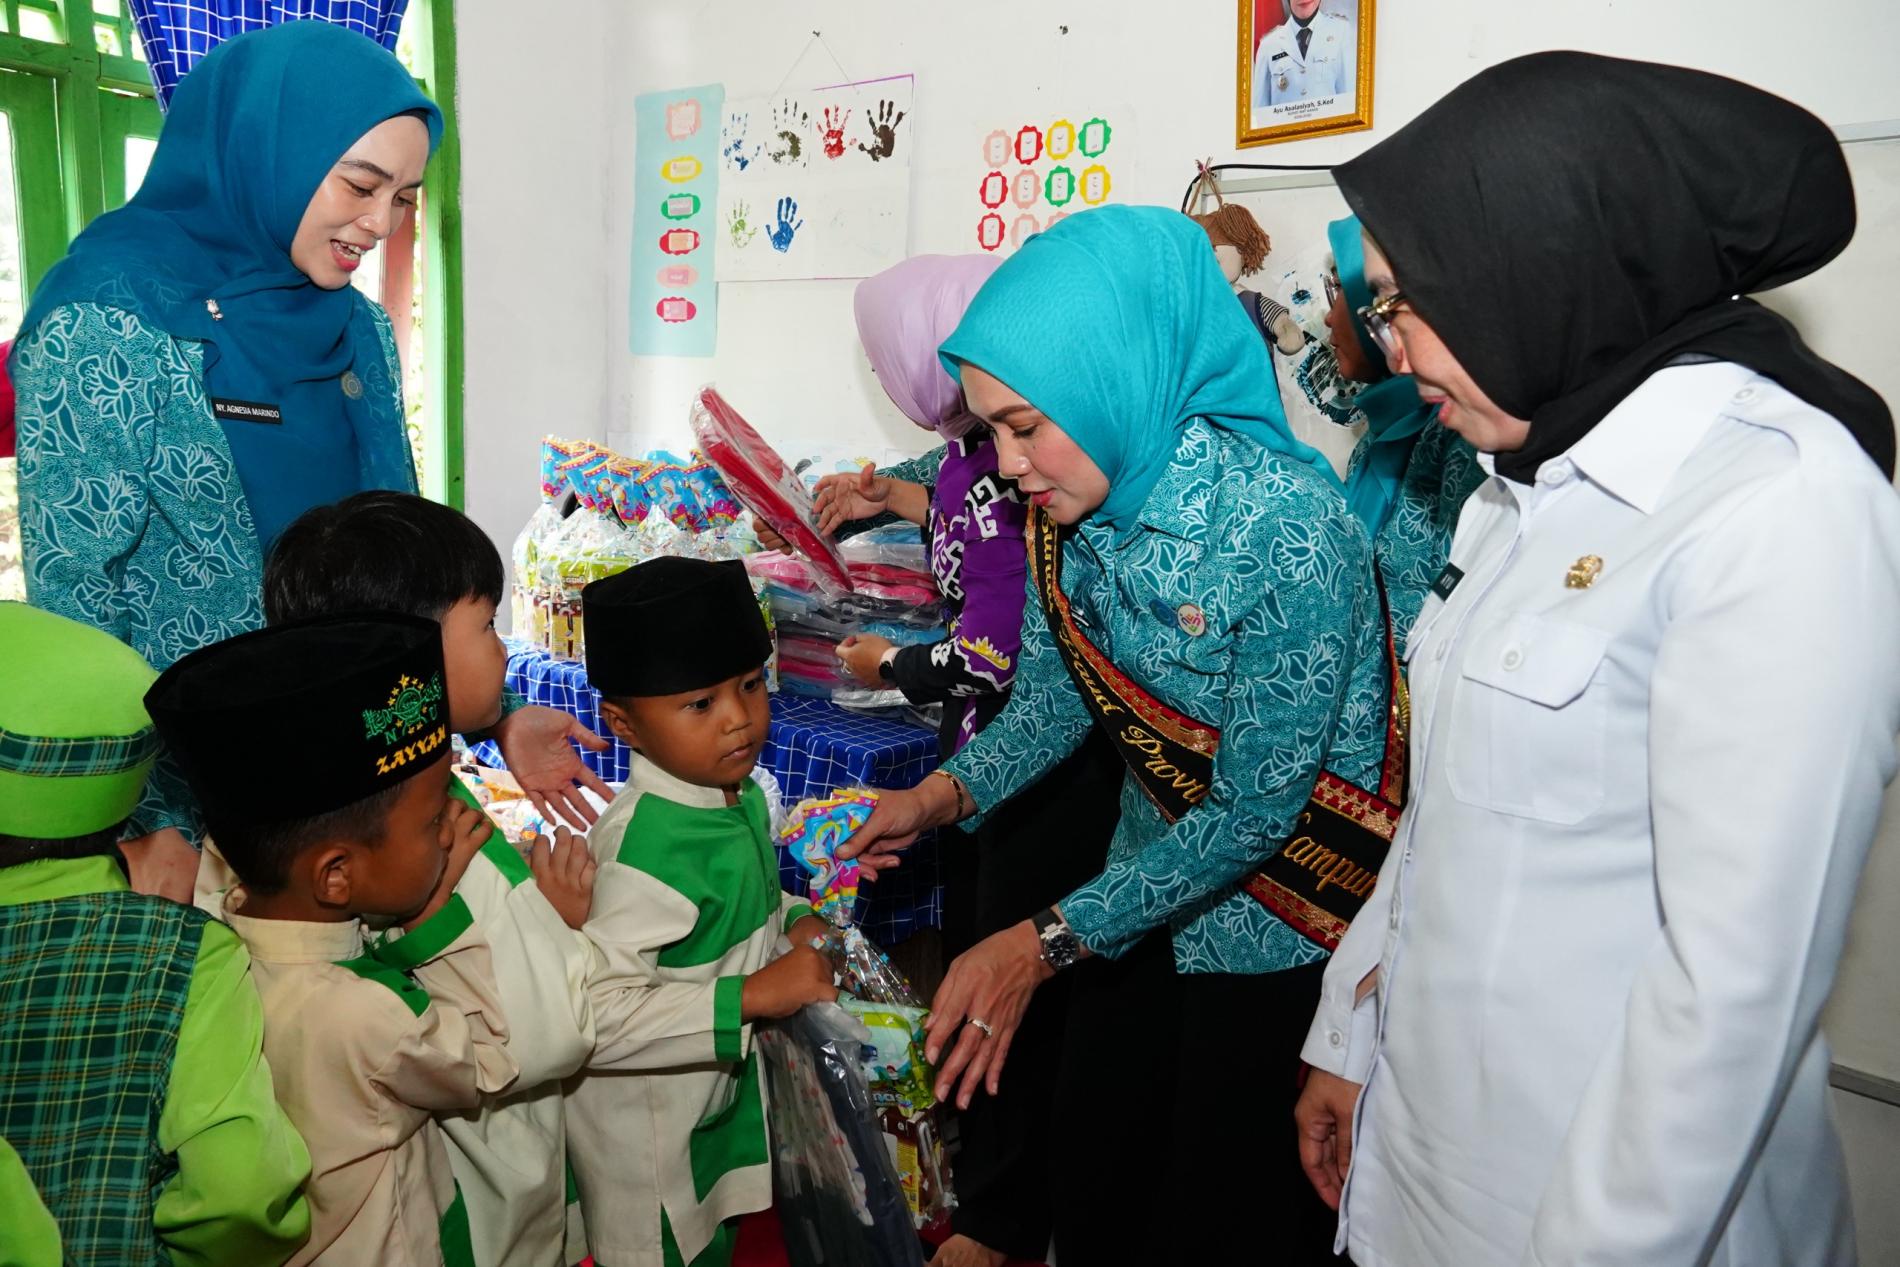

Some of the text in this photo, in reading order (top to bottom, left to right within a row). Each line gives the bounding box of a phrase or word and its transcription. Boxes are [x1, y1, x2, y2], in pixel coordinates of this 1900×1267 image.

[1317, 98, 1334, 107] S.Ked
[252, 408, 280, 418] MARINDO
[375, 723, 446, 776] ZAYYAN
